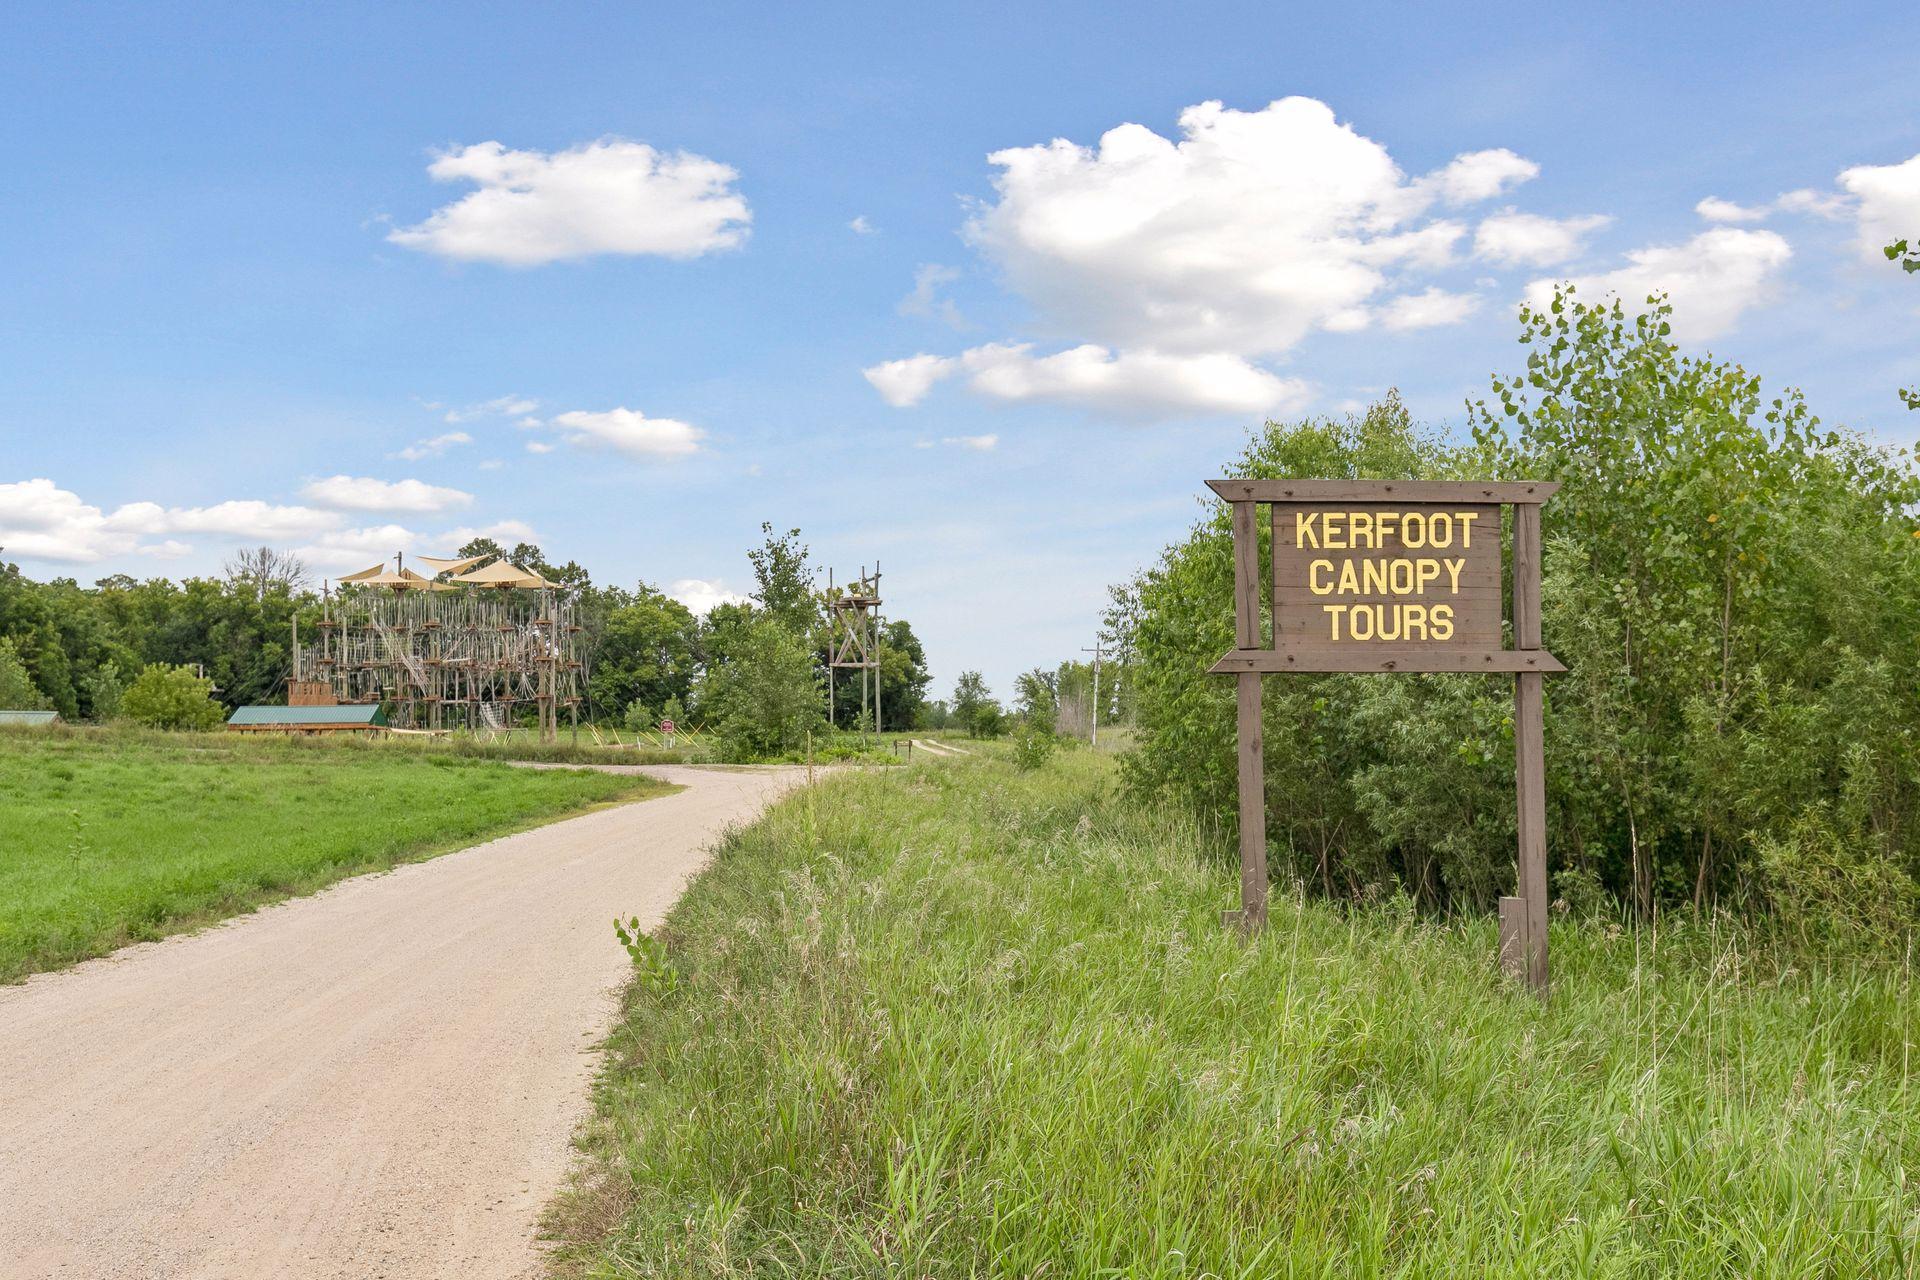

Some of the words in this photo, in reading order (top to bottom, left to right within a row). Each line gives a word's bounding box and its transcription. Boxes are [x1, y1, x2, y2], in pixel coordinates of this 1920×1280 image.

[1296, 512, 1479, 549] KERFOOT
[1309, 558, 1466, 595] CANOPY
[1323, 604, 1455, 641] TOURS
